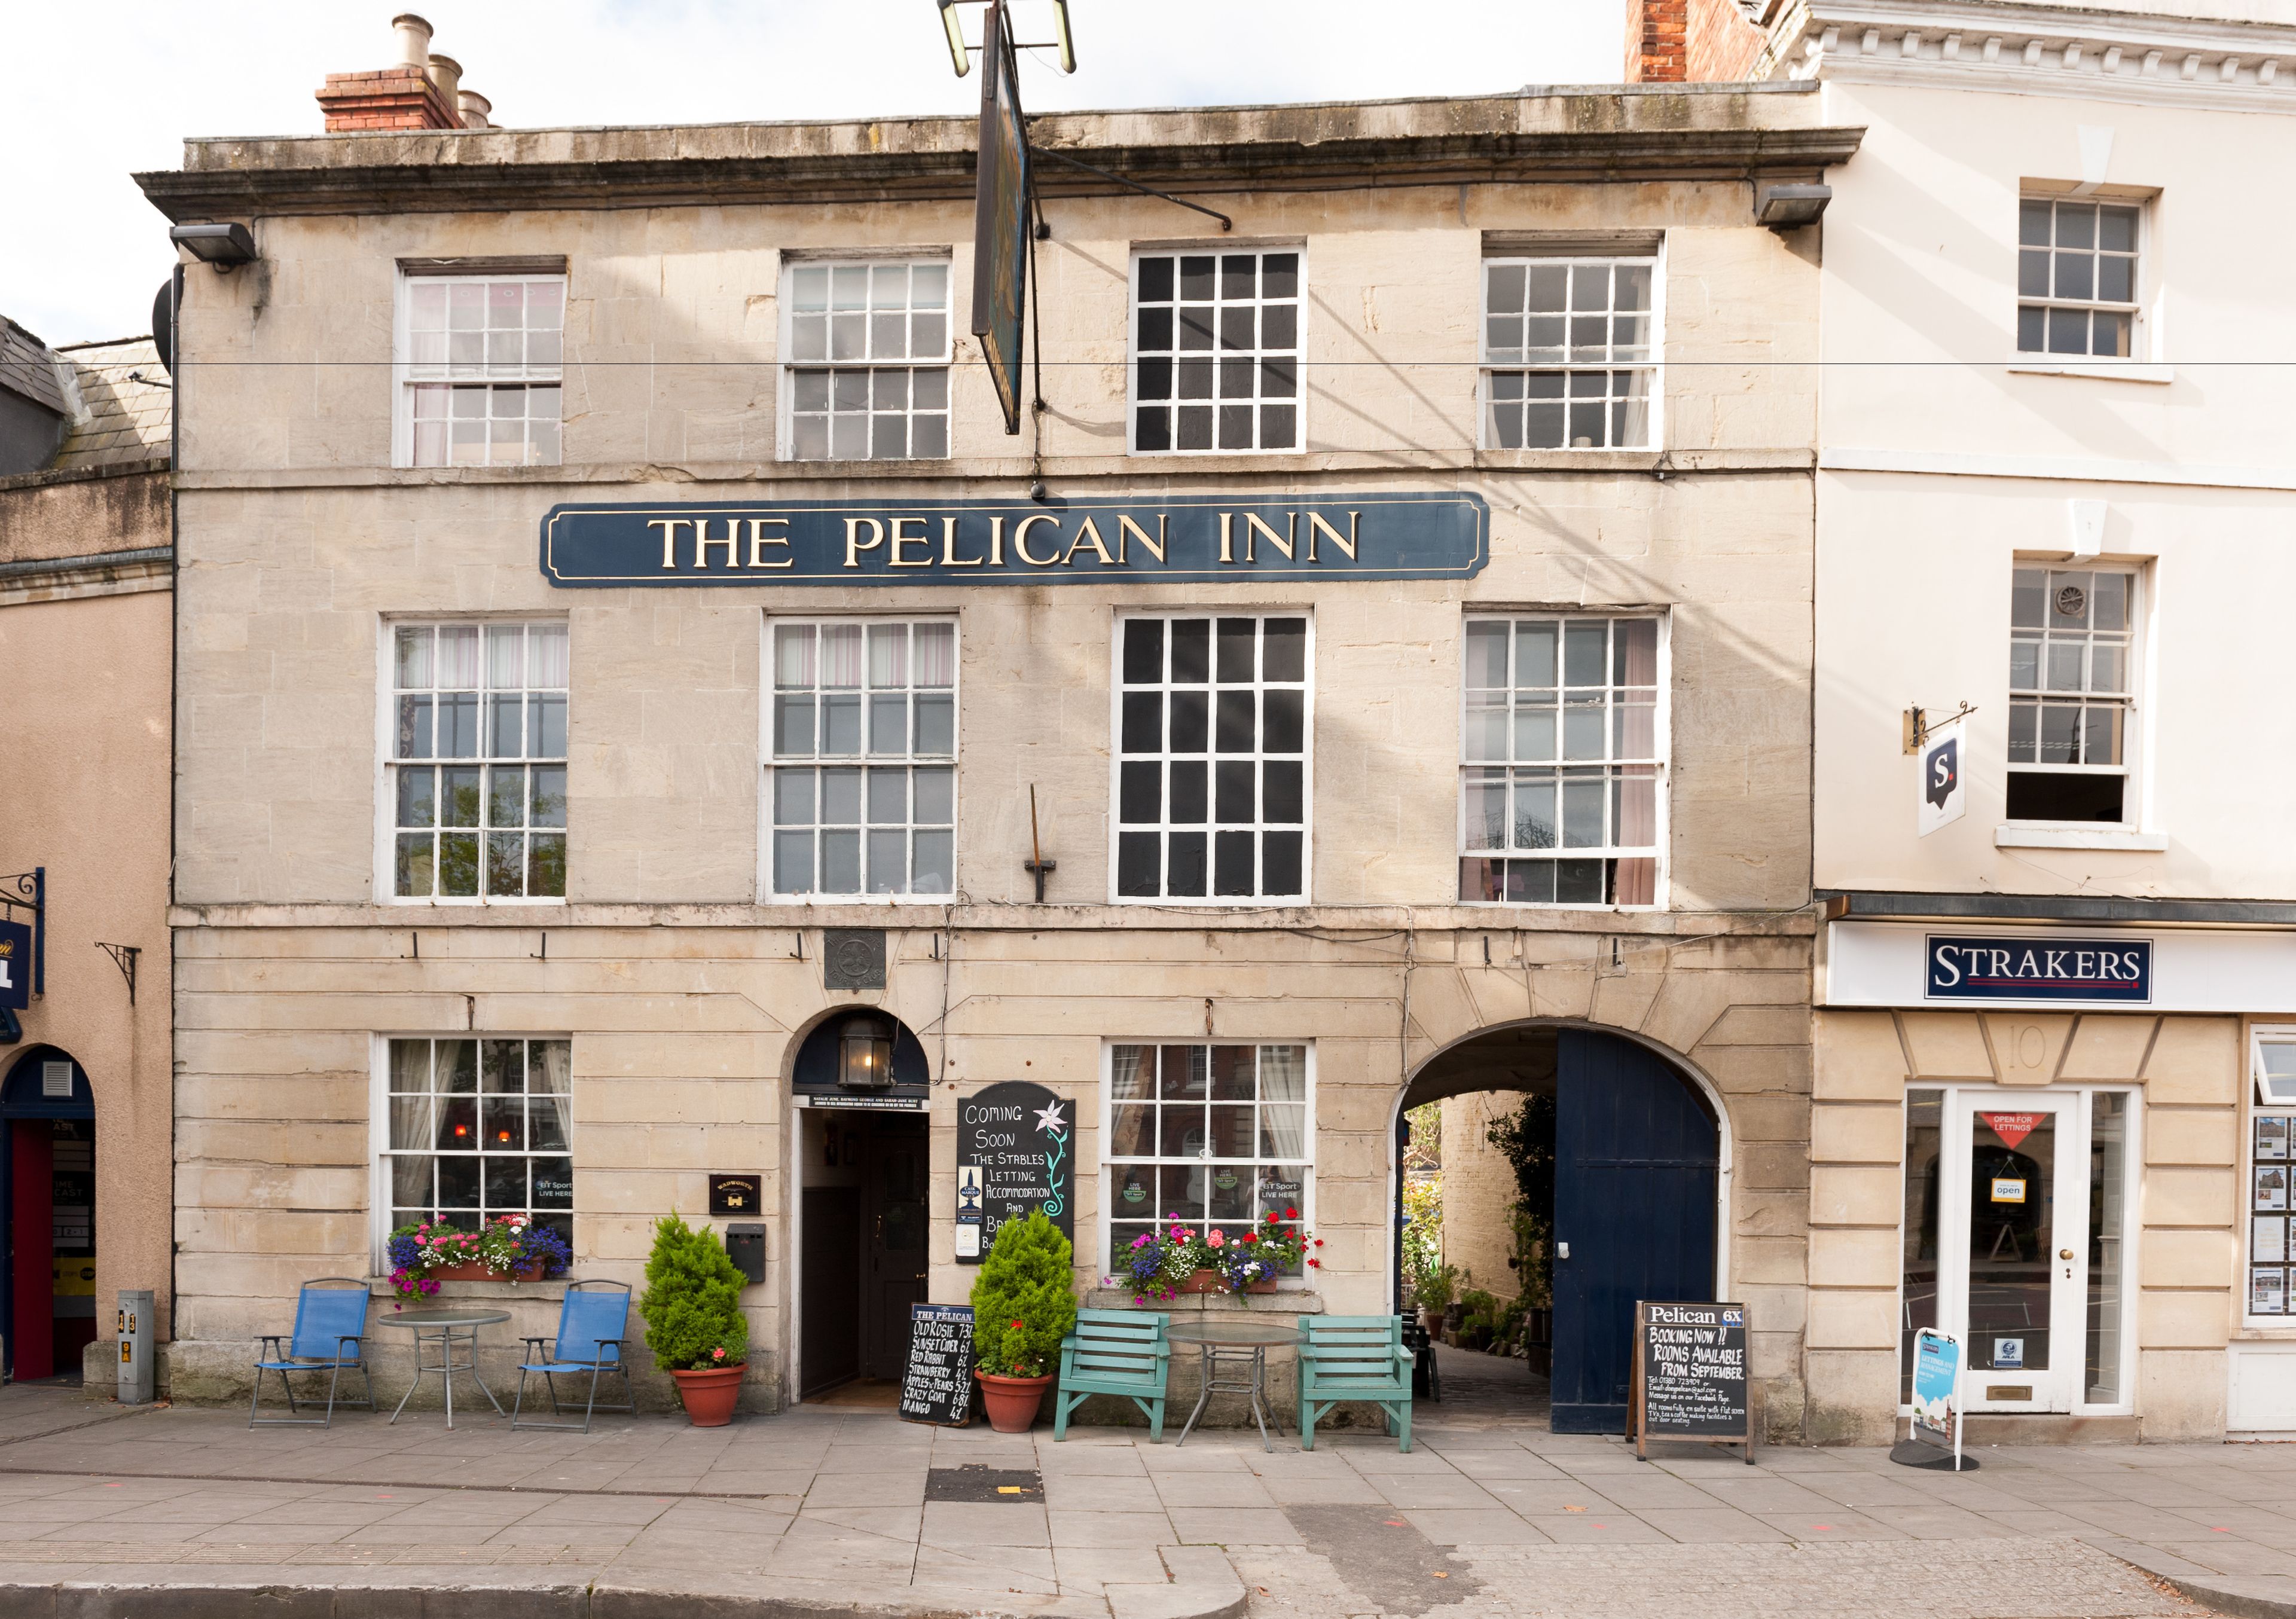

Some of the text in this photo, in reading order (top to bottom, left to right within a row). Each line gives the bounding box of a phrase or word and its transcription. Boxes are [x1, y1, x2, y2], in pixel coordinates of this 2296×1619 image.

[985, 328, 1015, 422] ADWORTH
[648, 511, 1361, 569] THE PELICAN INN
[826, 933, 844, 948] THE
[1934, 945, 2141, 987] STRAKERS
[2009, 1025, 2046, 1069] 10
[966, 1105, 1022, 1125] COMING
[976, 1129, 1015, 1148] SOON
[970, 1152, 1045, 1166] THE STABLES
[990, 1169, 1036, 1182] LETTING
[718, 1180, 753, 1191] WADWORTH
[987, 1184, 1050, 1199] ACCOMMODATION
[1276, 1183, 1297, 1192] Sport
[1997, 1187, 2020, 1195] open
[1006, 1203, 1024, 1212] AND
[917, 1311, 972, 1321] THE PELICAN
[1650, 1306, 1742, 1324] Pelican 6X
[914, 1320, 930, 1336] OLD
[929, 1321, 955, 1339] ROSIE
[1649, 1326, 1727, 1345] BOOKING NOW !!
[912, 1336, 971, 1354] SUNSET CIDER 6%
[911, 1349, 968, 1367] RED RABBIT 6%
[1653, 1343, 1743, 1366] ROOMS AVAILABLE
[909, 1361, 967, 1380] STRAWBERRY 4%
[1661, 1361, 1745, 1380] FROM SEPTEMBER.
[906, 1374, 929, 1389] APPLES
[933, 1377, 954, 1392] PEARS
[1648, 1383, 1665, 1392] Email:
[1659, 1376, 1675, 1385] 01380
[1678, 1377, 1700, 1386] 723909
[904, 1386, 928, 1401] CRAZY
[928, 1389, 947, 1404] GOAT
[1648, 1391, 1670, 1401] Message
[1694, 1393, 1717, 1401] Facebook
[902, 1399, 963, 1420] MANGO 4%
[1647, 1401, 1657, 1410] All
[1672, 1403, 1684, 1412] fully
[1693, 1404, 1706, 1412] suite
[1708, 1405, 1719, 1413] with
[1720, 1406, 1731, 1415] flat
[1689, 1413, 1705, 1422] making
